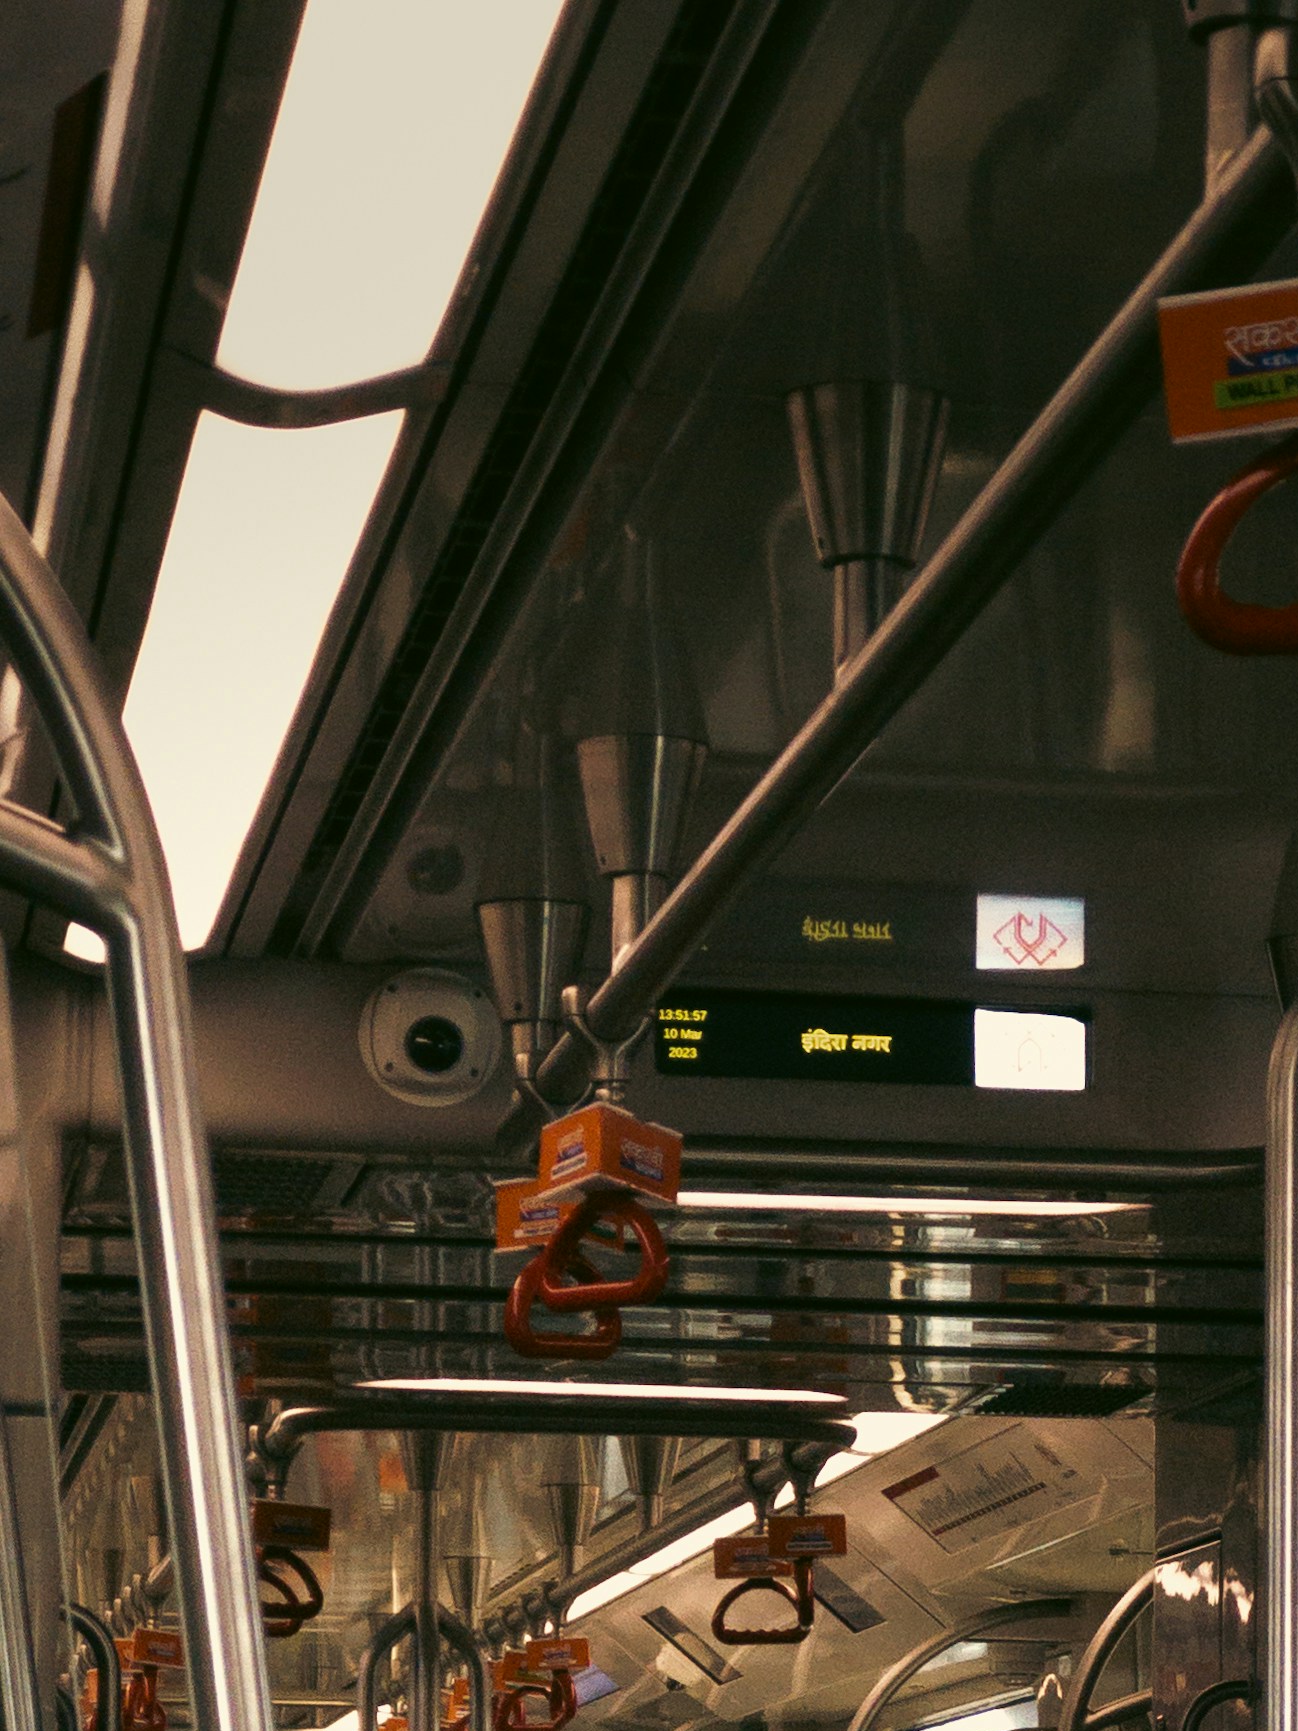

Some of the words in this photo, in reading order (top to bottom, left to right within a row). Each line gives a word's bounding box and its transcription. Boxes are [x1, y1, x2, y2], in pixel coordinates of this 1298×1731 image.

[1227, 378, 1280, 401] WALL
[658, 1009, 708, 1022] 13:51:57
[663, 1028, 678, 1040] 10
[680, 1028, 703, 1041] Mar
[801, 1028, 848, 1054] इंदिरा
[851, 1034, 892, 1054] नगर
[668, 1046, 698, 1059] 2023
